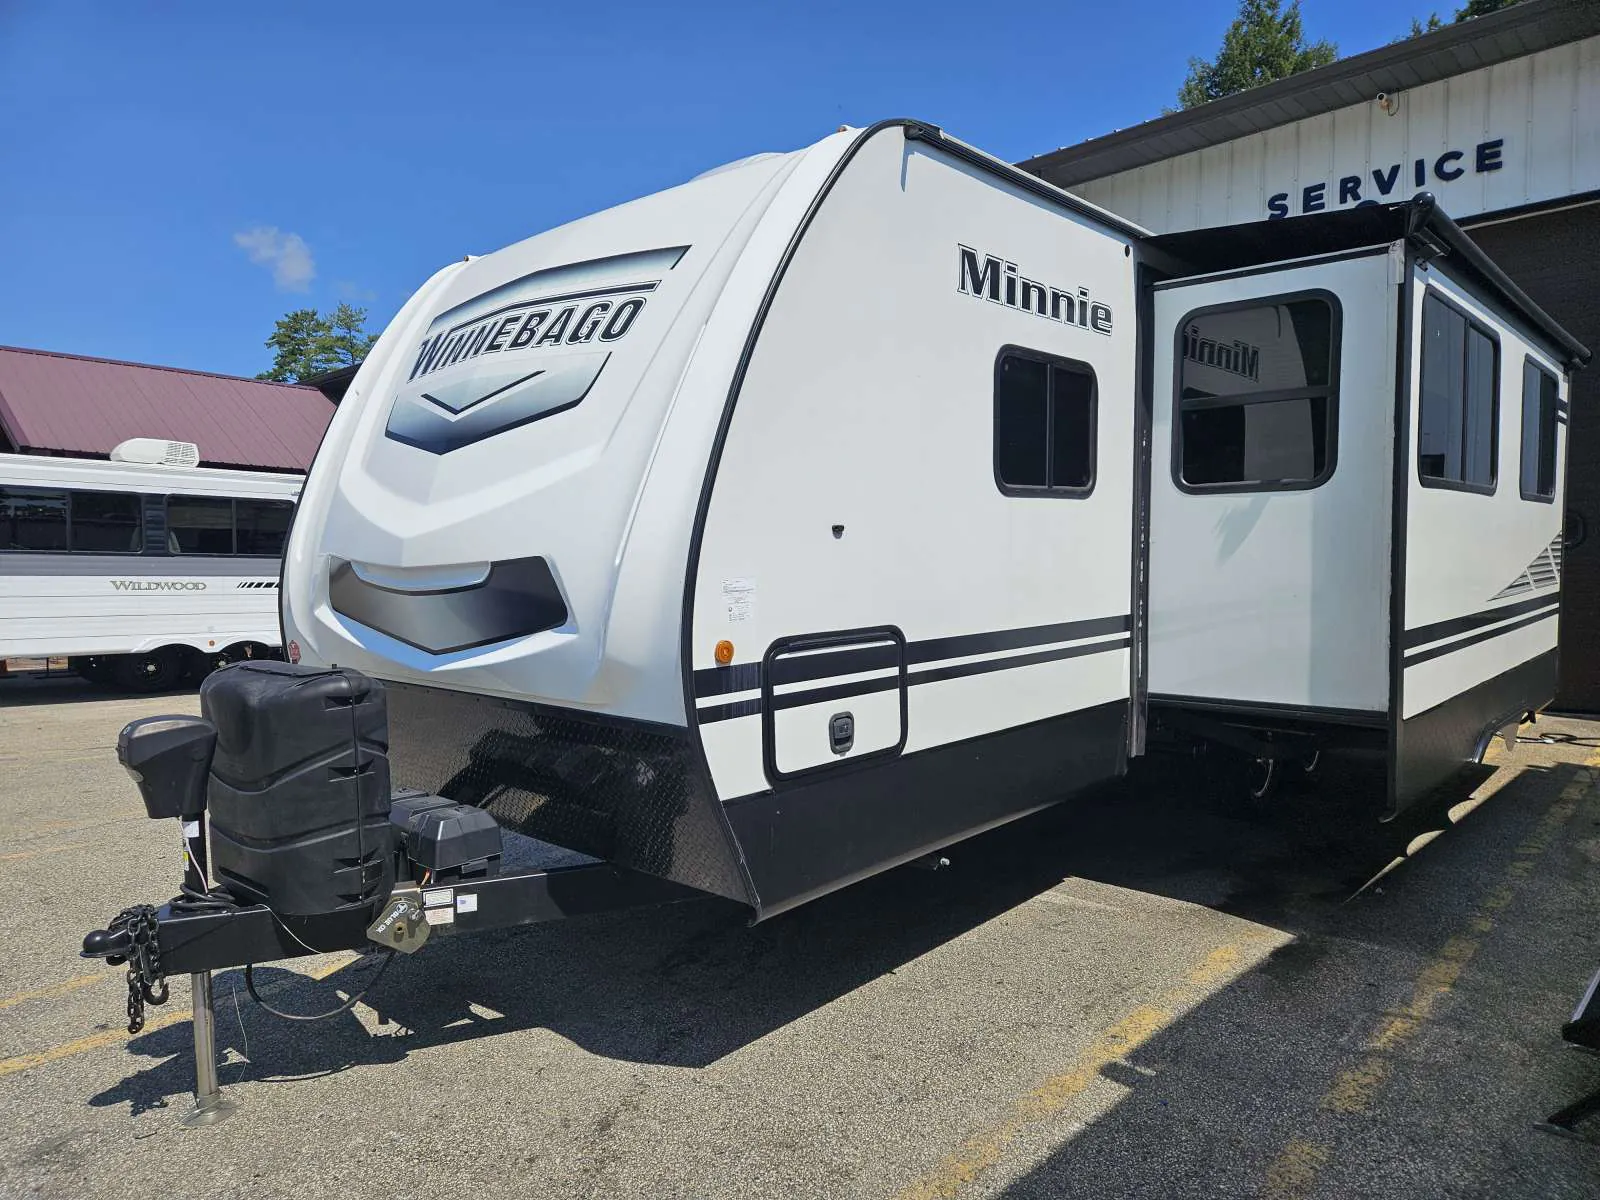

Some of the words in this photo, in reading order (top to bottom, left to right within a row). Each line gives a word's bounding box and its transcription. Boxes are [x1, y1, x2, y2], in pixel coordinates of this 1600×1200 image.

[1267, 139, 1504, 220] SERVICE
[957, 243, 1114, 337] Minnie
[407, 296, 648, 384] WINNEBAGO
[109, 580, 207, 591] WILDWOOD
